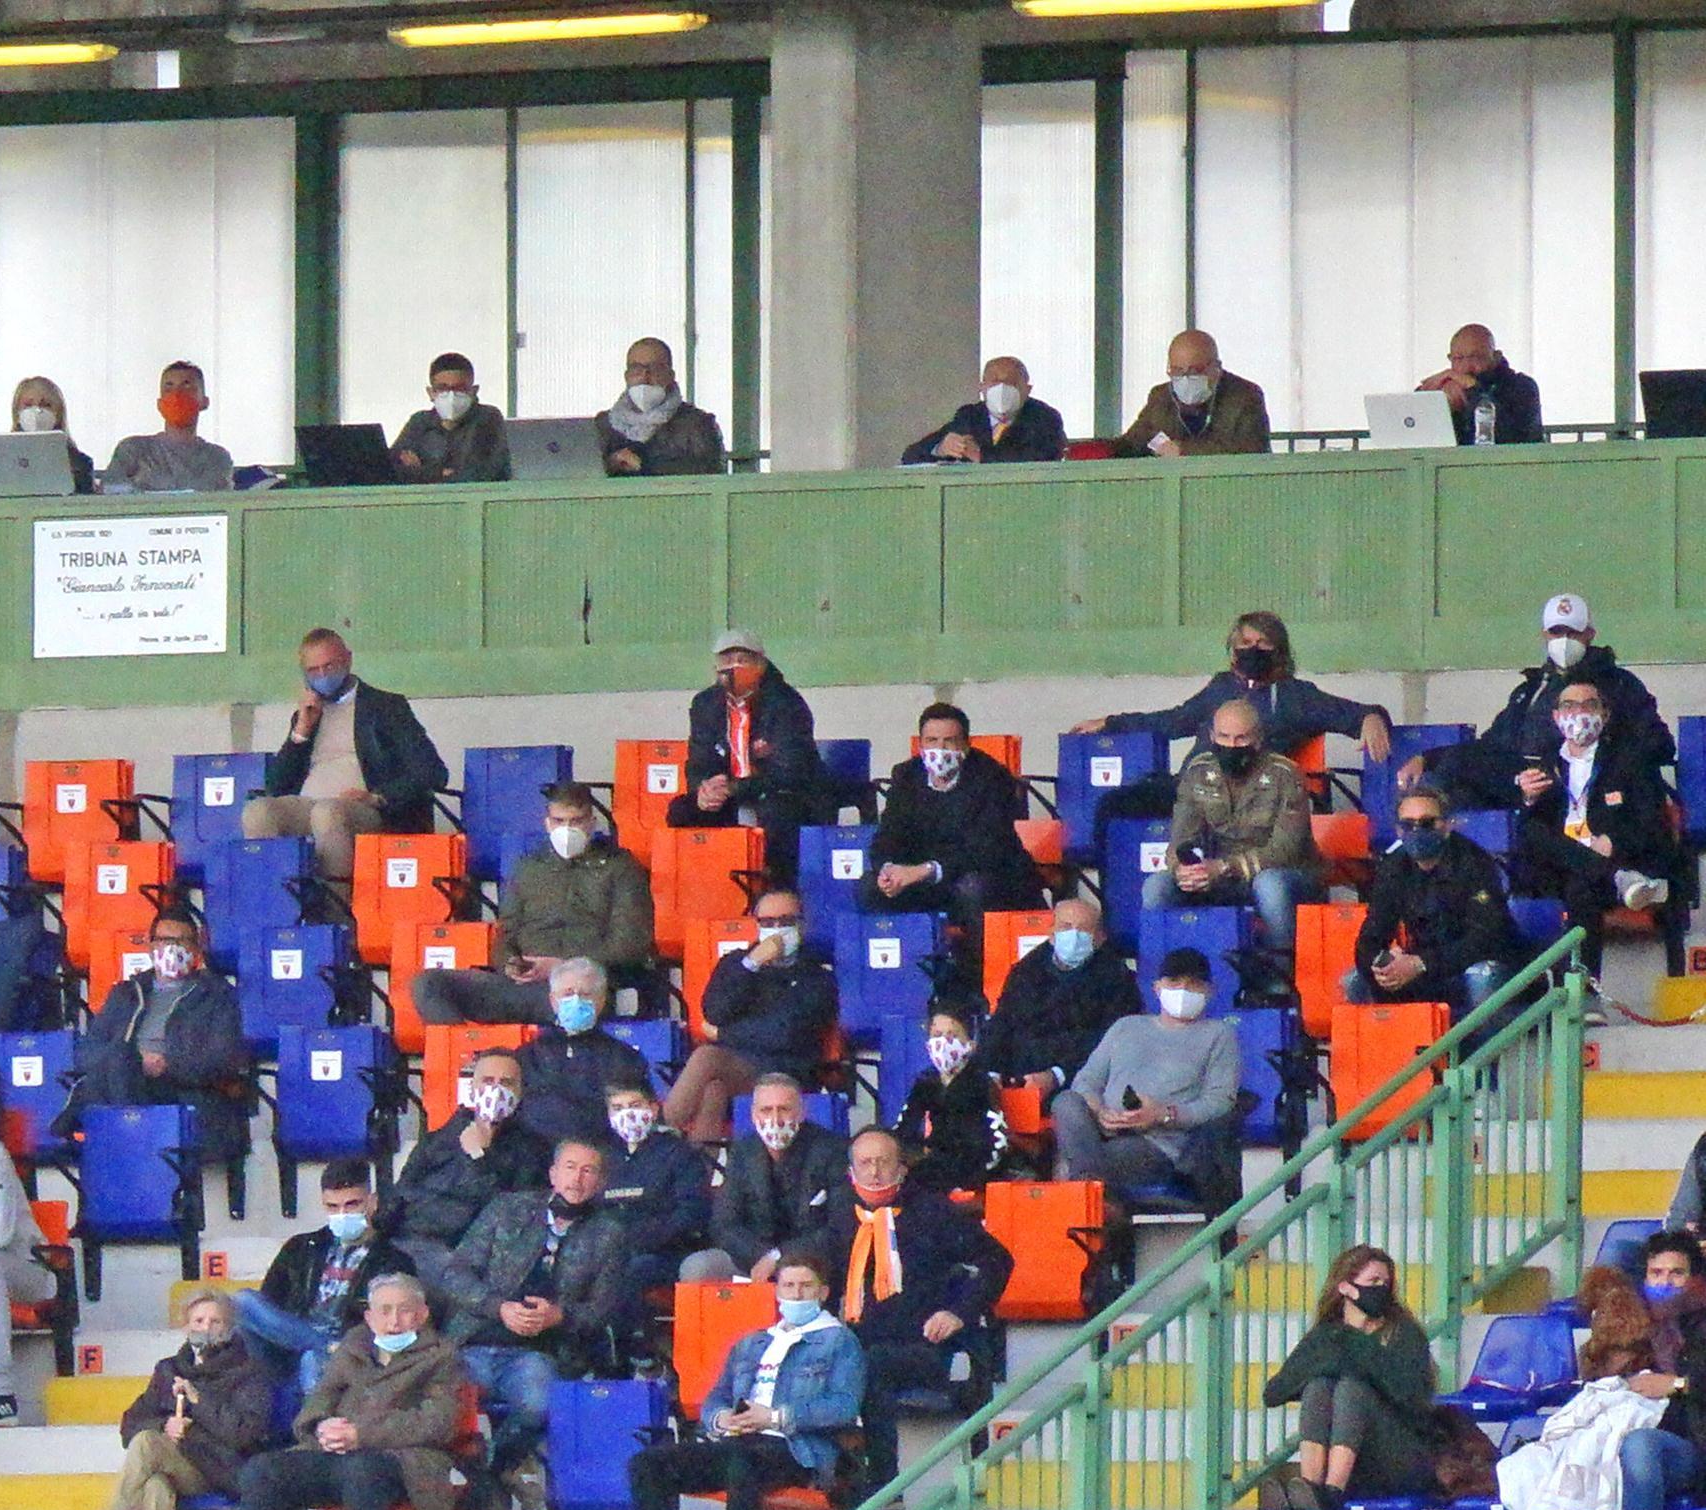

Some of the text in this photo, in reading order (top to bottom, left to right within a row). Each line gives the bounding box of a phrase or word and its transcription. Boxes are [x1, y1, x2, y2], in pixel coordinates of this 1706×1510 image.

[59, 549, 202, 568] TRIBUNA STAMPA
[209, 1255, 222, 1277] E
[84, 1348, 97, 1370] F
